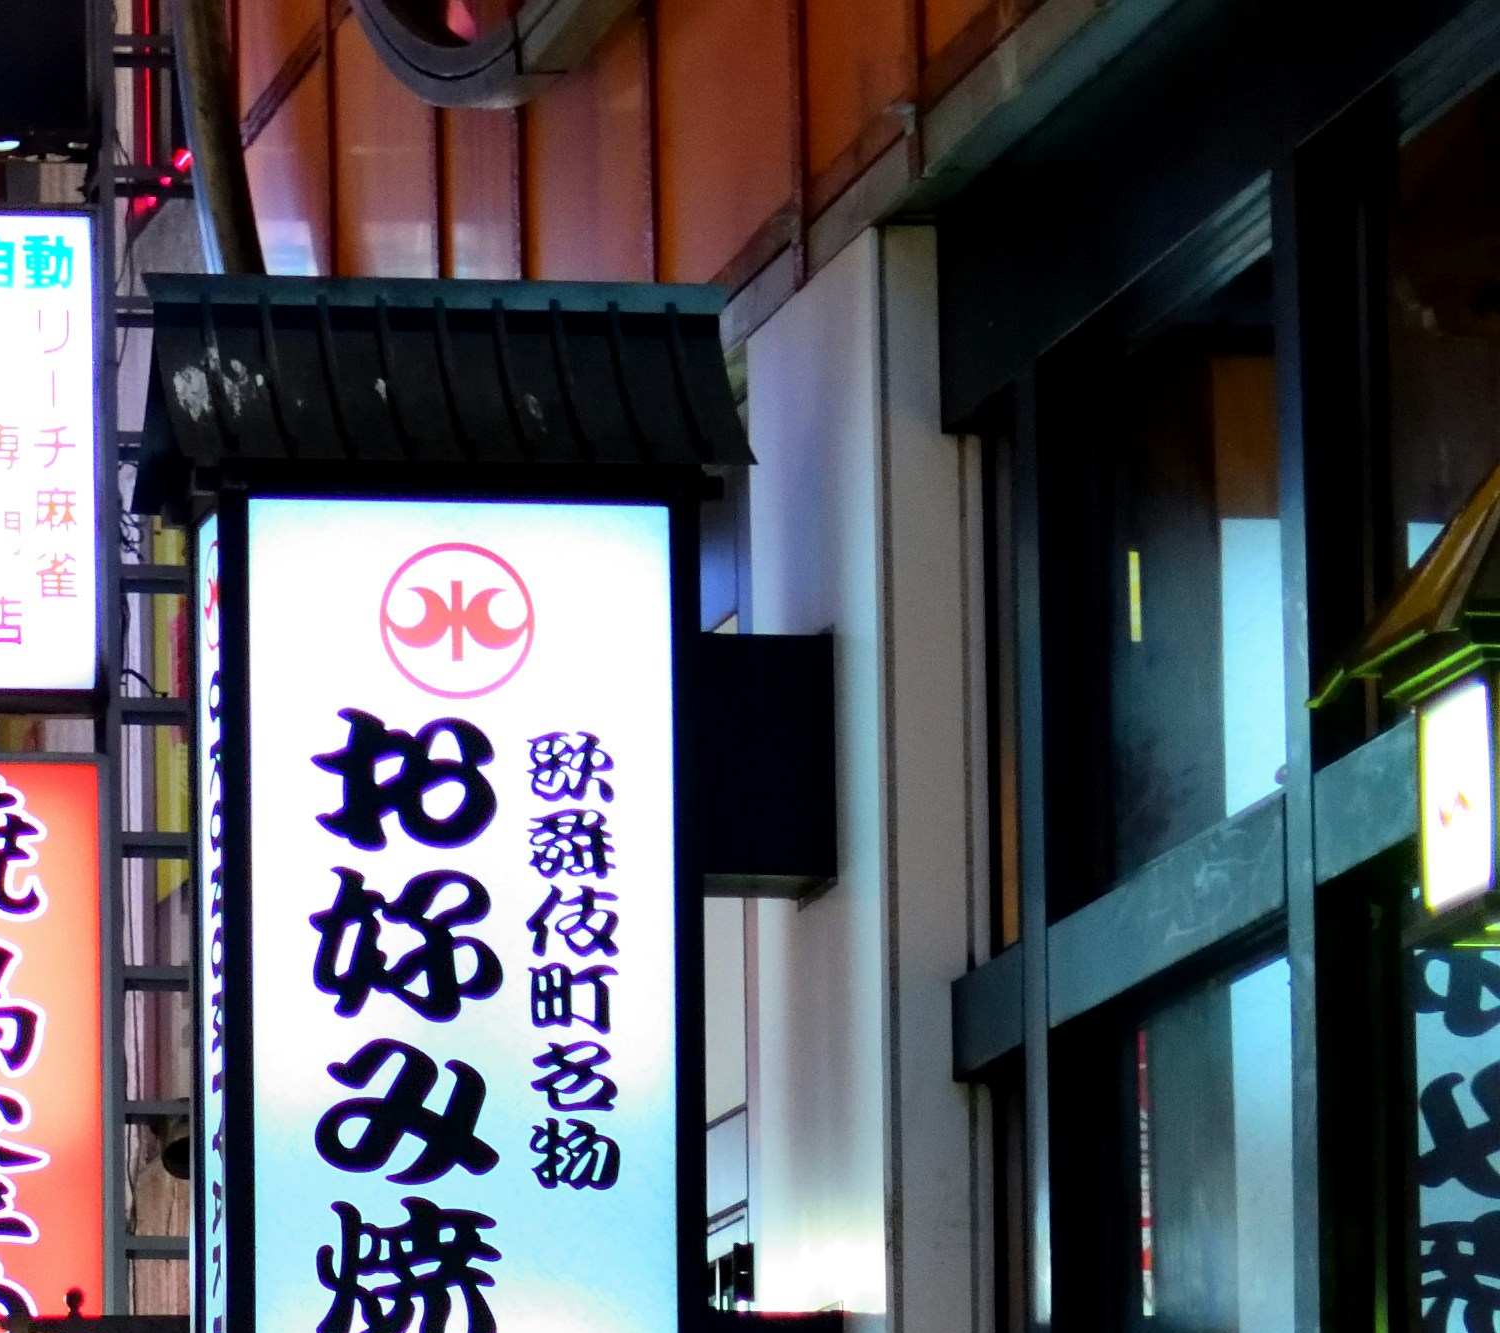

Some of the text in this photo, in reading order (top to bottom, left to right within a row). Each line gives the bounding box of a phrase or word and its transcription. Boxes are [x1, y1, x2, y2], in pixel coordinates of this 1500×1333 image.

[32, 306, 79, 601] リーチ麻雀
